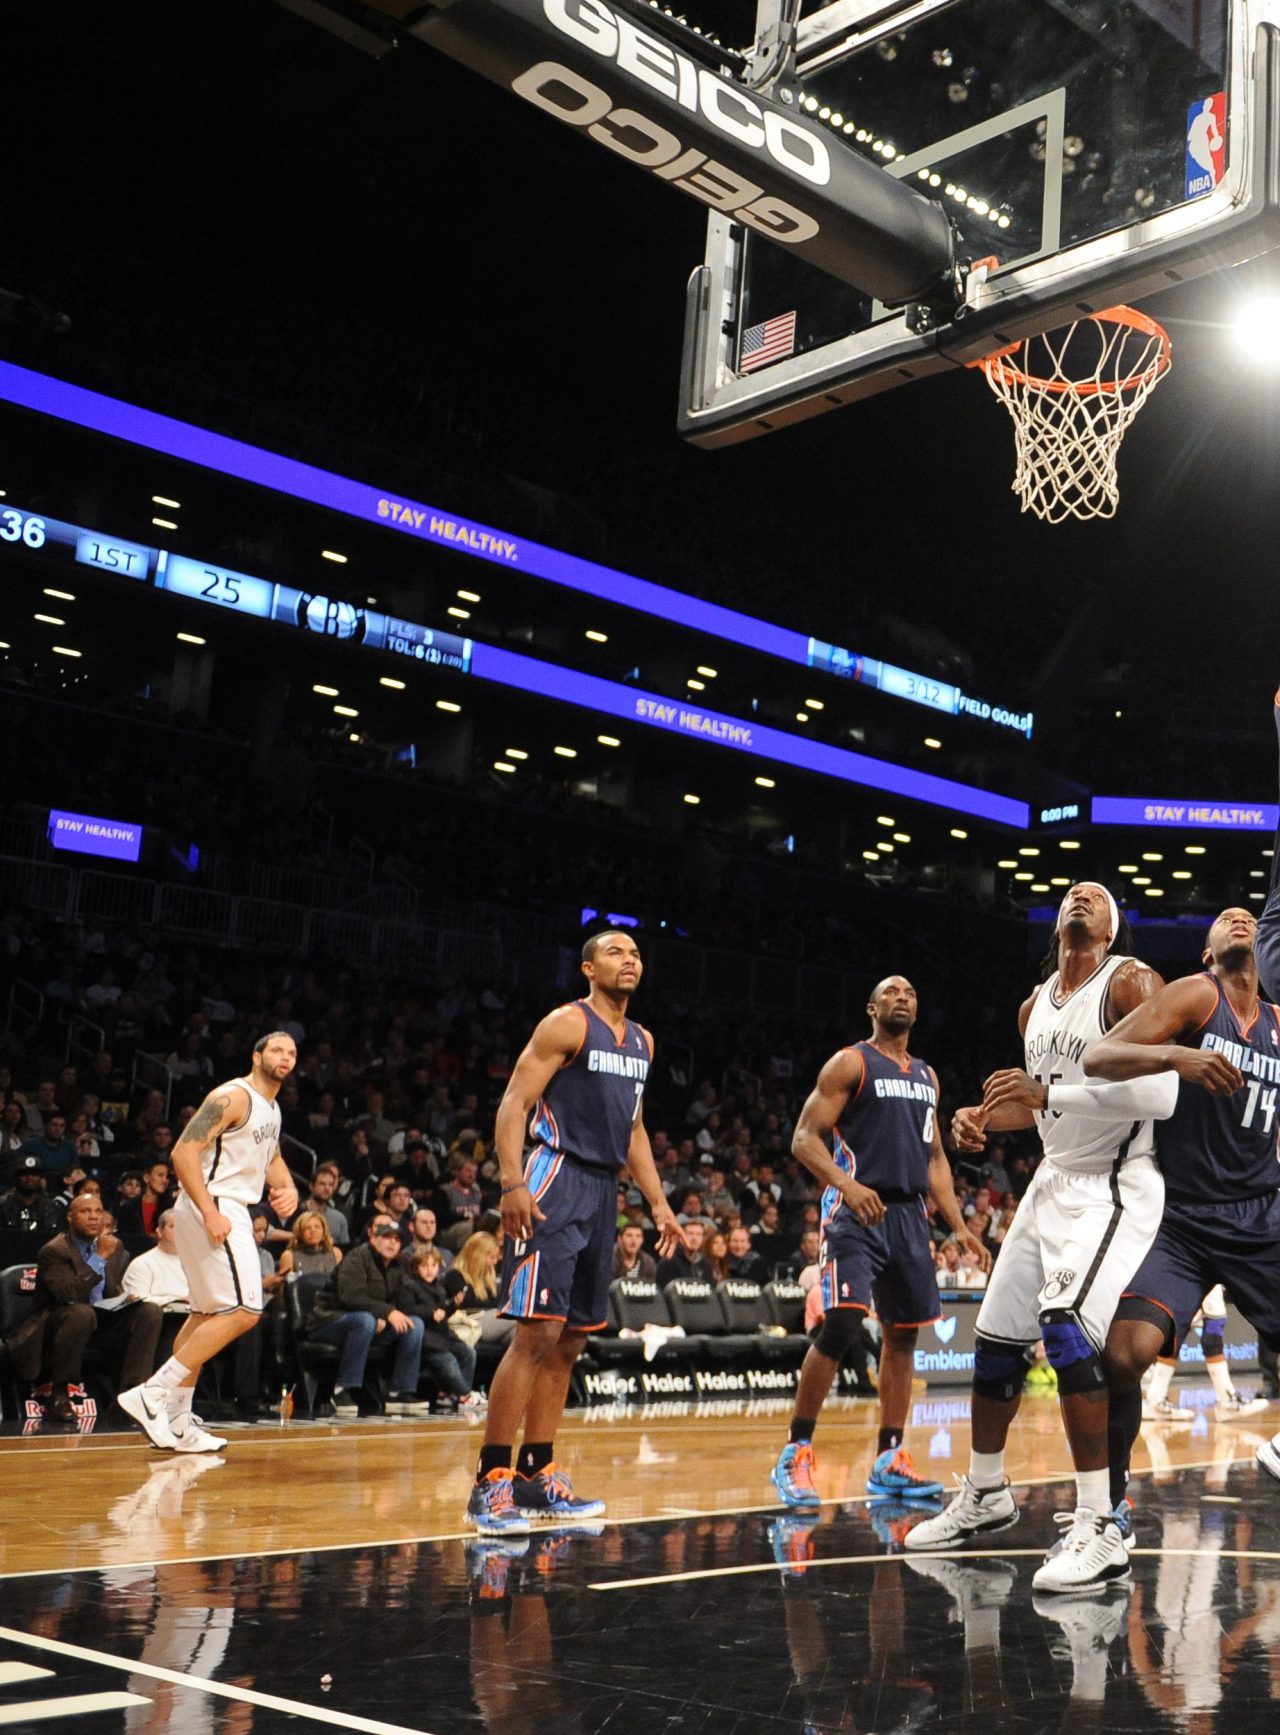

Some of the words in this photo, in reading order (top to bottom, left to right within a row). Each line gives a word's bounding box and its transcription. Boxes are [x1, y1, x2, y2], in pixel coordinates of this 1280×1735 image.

[544, 0, 830, 185] GEICO
[511, 61, 820, 243] GEICO
[1188, 175, 1211, 194] NBA
[377, 499, 426, 528] STAY
[430, 516, 518, 561] HEALTHY.
[90, 543, 138, 572] 1ST
[200, 570, 242, 604] 25
[906, 676, 941, 703] 3/12
[636, 698, 677, 723] STAY
[679, 711, 753, 746] HEALTHY.
[959, 696, 990, 719] FIELD
[991, 708, 1027, 731] GOALS
[1062, 805, 1079, 820] PM
[1144, 805, 1184, 822] STAY
[1188, 807, 1266, 826] HEALTHY.
[57, 818, 83, 833] STAY
[85, 824, 135, 842] HEALTHY.
[632, 1081, 644, 1121] 7
[621, 1280, 657, 1297] Haier
[675, 1281, 711, 1297] Haier
[726, 1282, 760, 1298] Haier
[773, 1283, 805, 1298] Haier
[914, 1349, 976, 1371] Emblem
[585, 1374, 637, 1395] Haier
[643, 1373, 693, 1393] Haier
[696, 1371, 746, 1391] Haier
[747, 1369, 795, 1389] Haier
